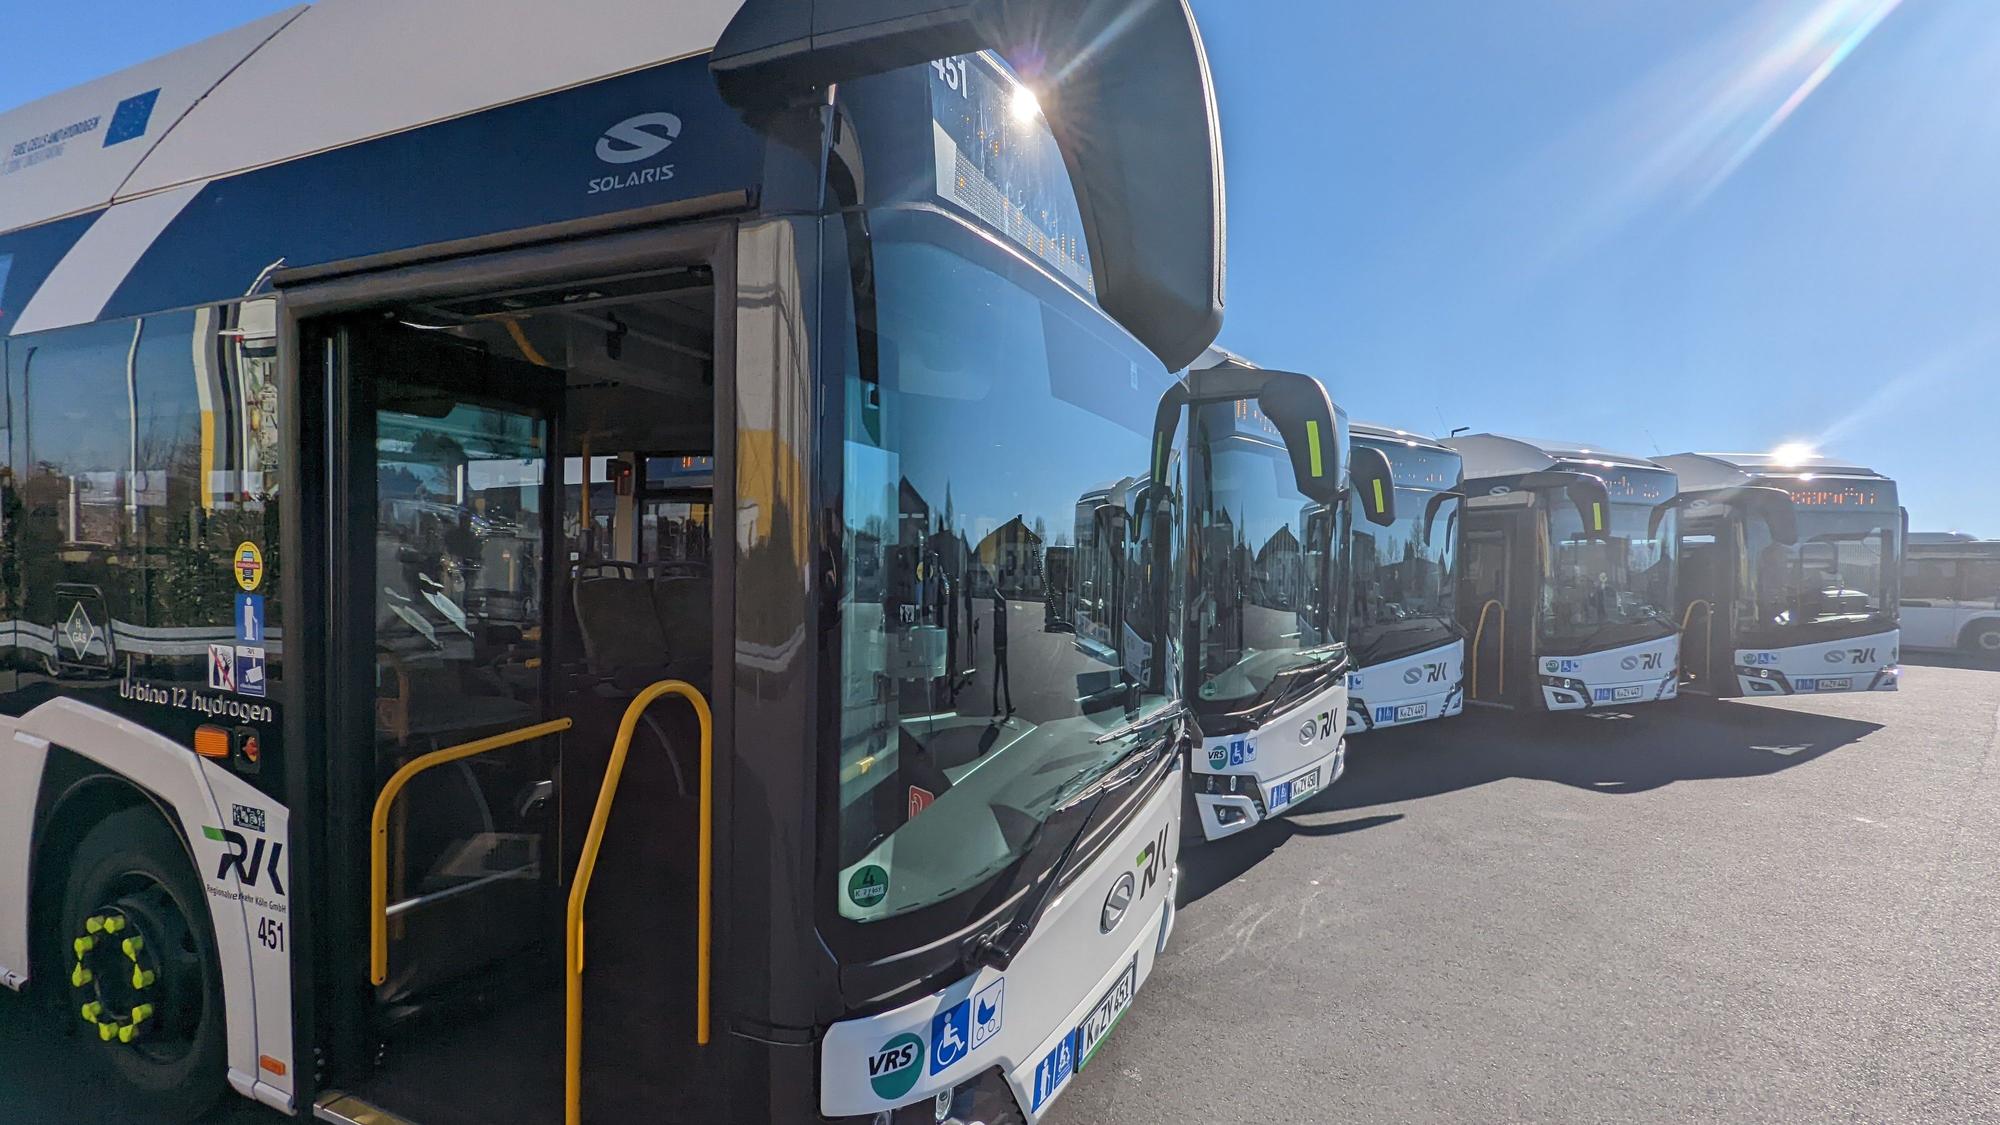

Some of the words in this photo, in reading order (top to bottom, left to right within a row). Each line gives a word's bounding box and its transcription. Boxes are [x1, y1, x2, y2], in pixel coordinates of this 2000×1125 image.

[588, 164, 674, 194] SOLARIS
[120, 678, 168, 704] Urbino
[172, 686, 188, 708] 12
[192, 690, 272, 724] hydrogen
[1208, 750, 1224, 760] VRS
[863, 867, 875, 885] 4
[258, 917, 284, 952] 451
[869, 1044, 913, 1076] VRS
